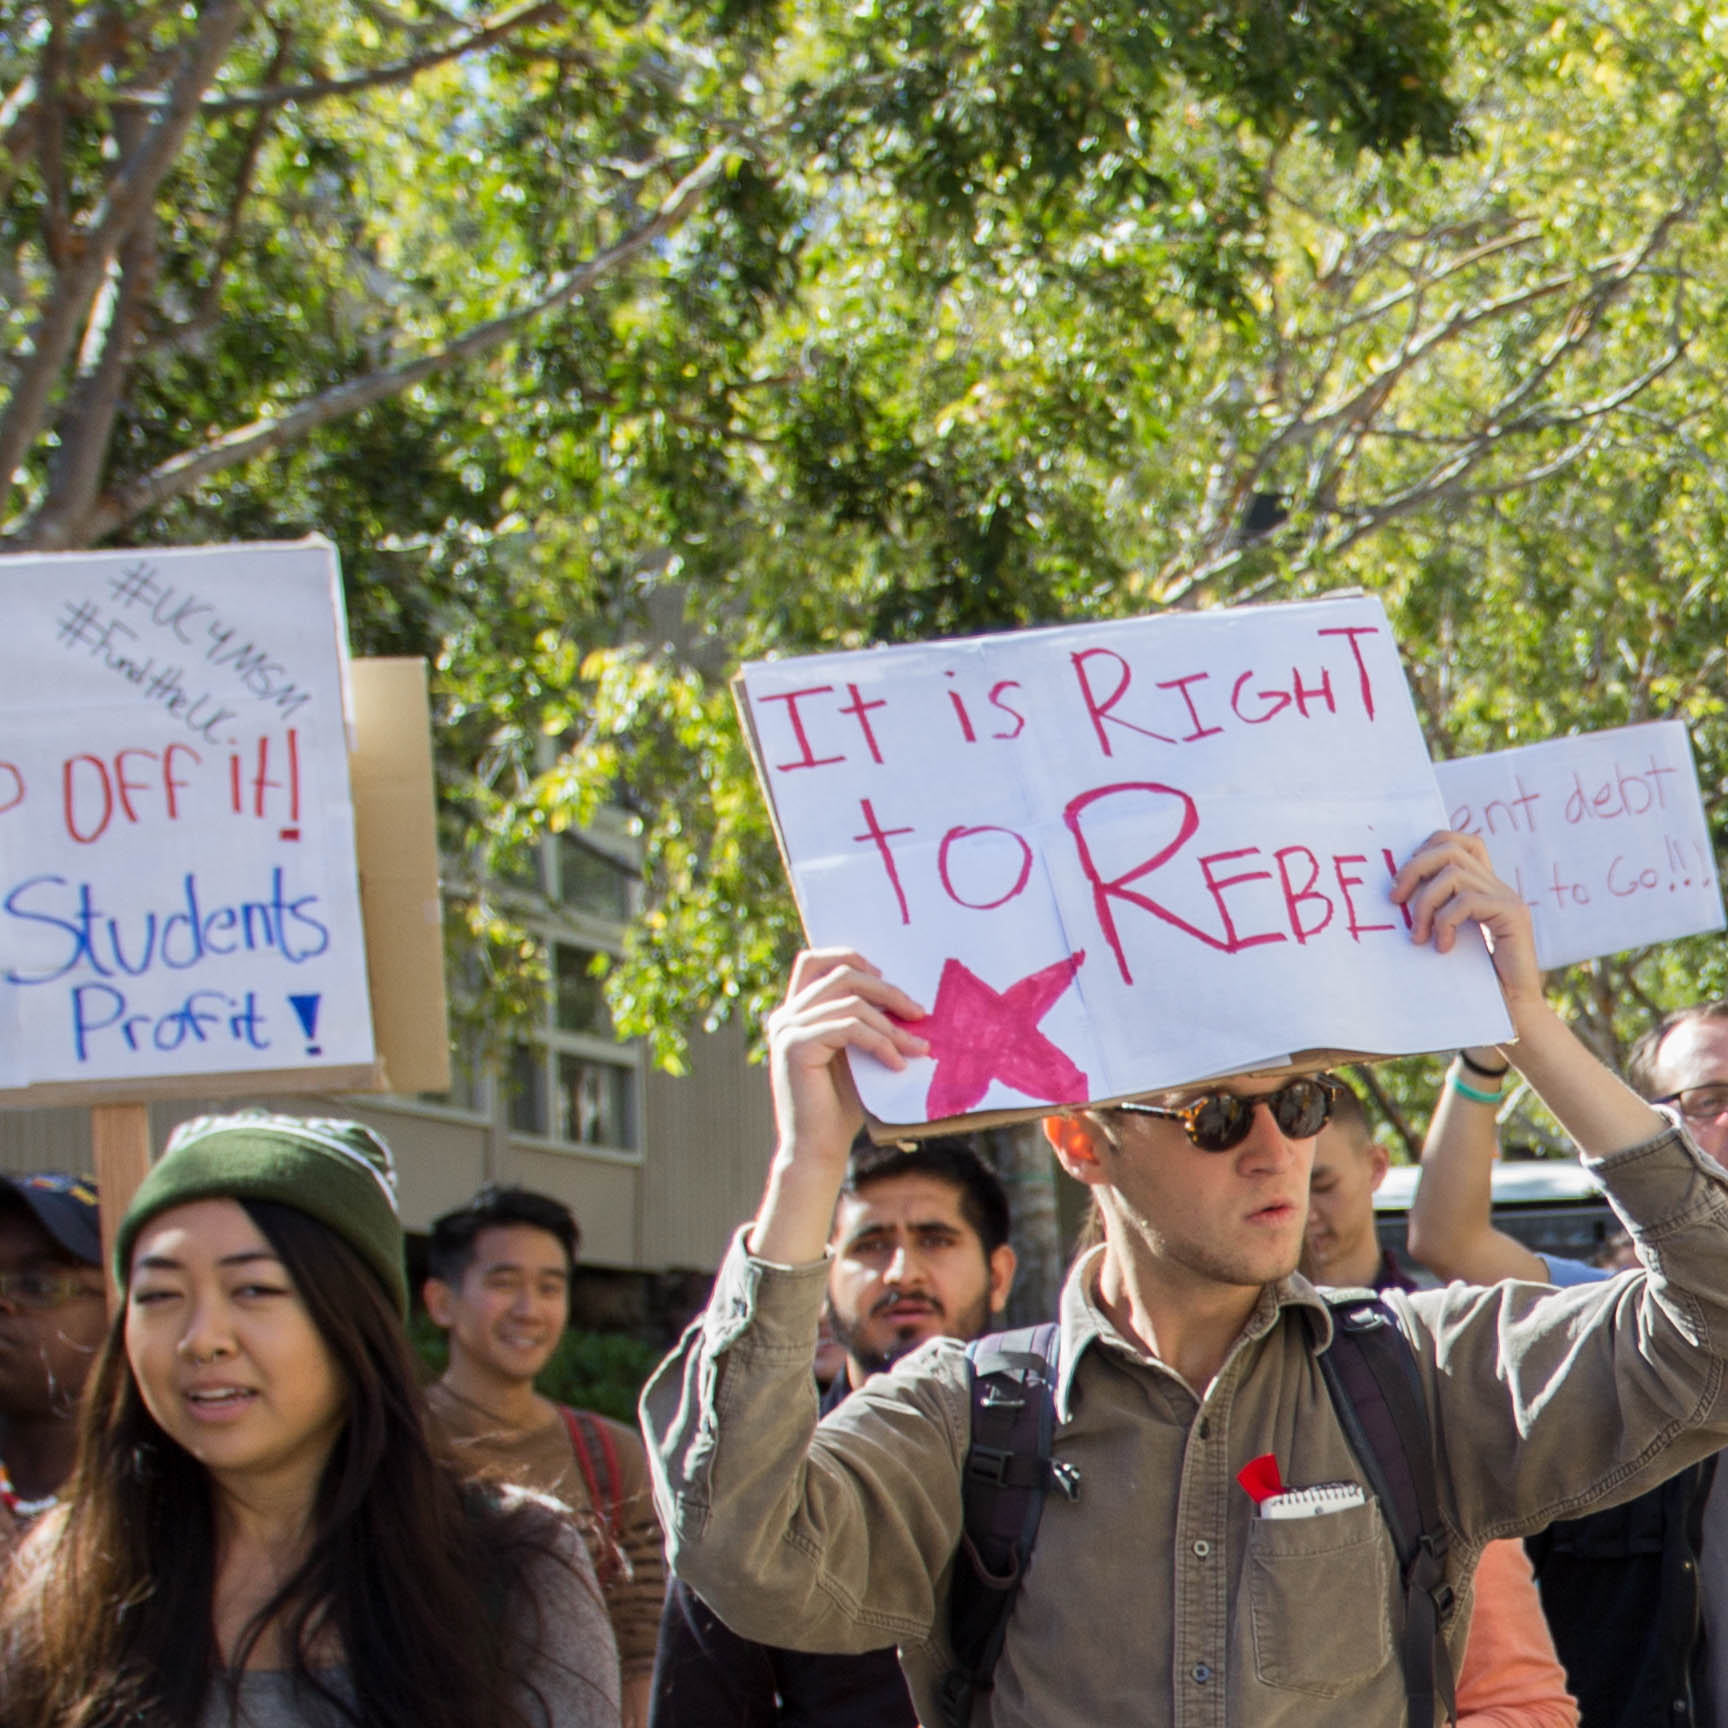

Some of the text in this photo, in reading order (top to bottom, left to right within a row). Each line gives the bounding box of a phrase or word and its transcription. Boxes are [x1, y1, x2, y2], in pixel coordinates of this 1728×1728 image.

[758, 626, 1378, 772] It is RIGHT
[1450, 755, 1676, 835] ent debt
[854, 799, 1032, 925] to
[1549, 862, 1591, 909] to
[1, 865, 329, 985] Students
